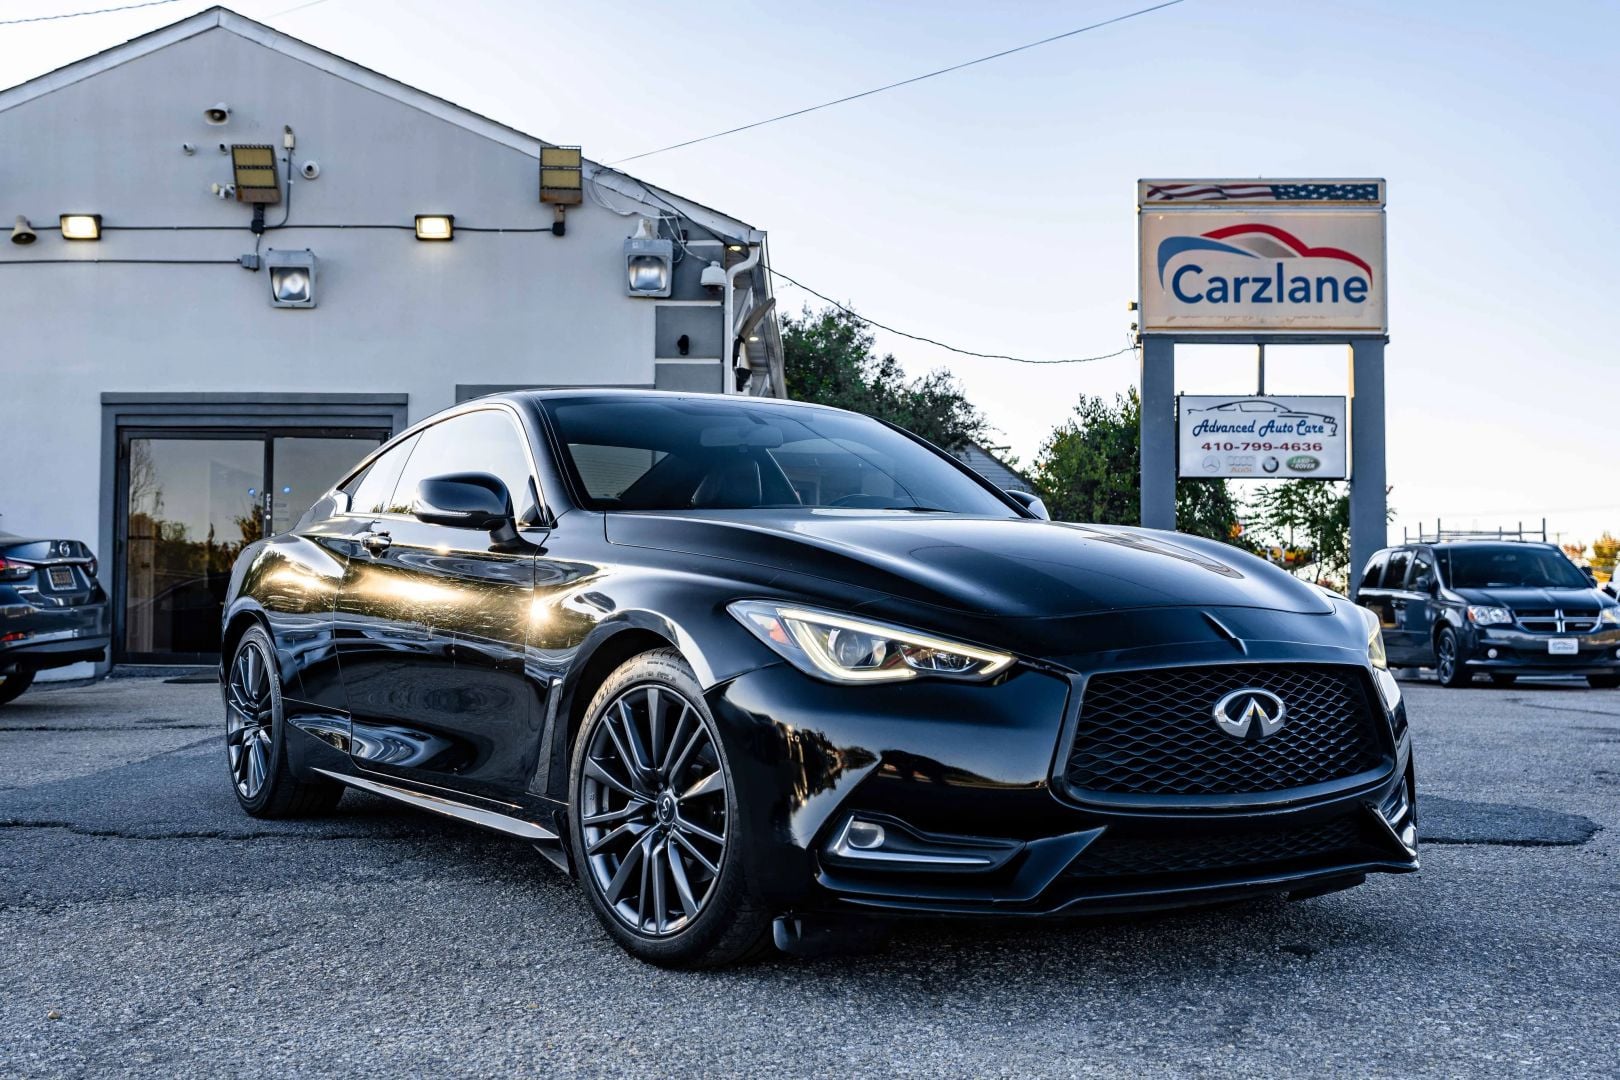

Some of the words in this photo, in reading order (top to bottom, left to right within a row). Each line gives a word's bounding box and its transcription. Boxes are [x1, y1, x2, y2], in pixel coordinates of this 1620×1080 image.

[1172, 262, 1368, 304] Carzlane
[1192, 419, 1256, 437] Advanced
[1258, 419, 1294, 437] Auto
[1296, 419, 1324, 436] Care
[1201, 442, 1323, 451] 410-799-4636
